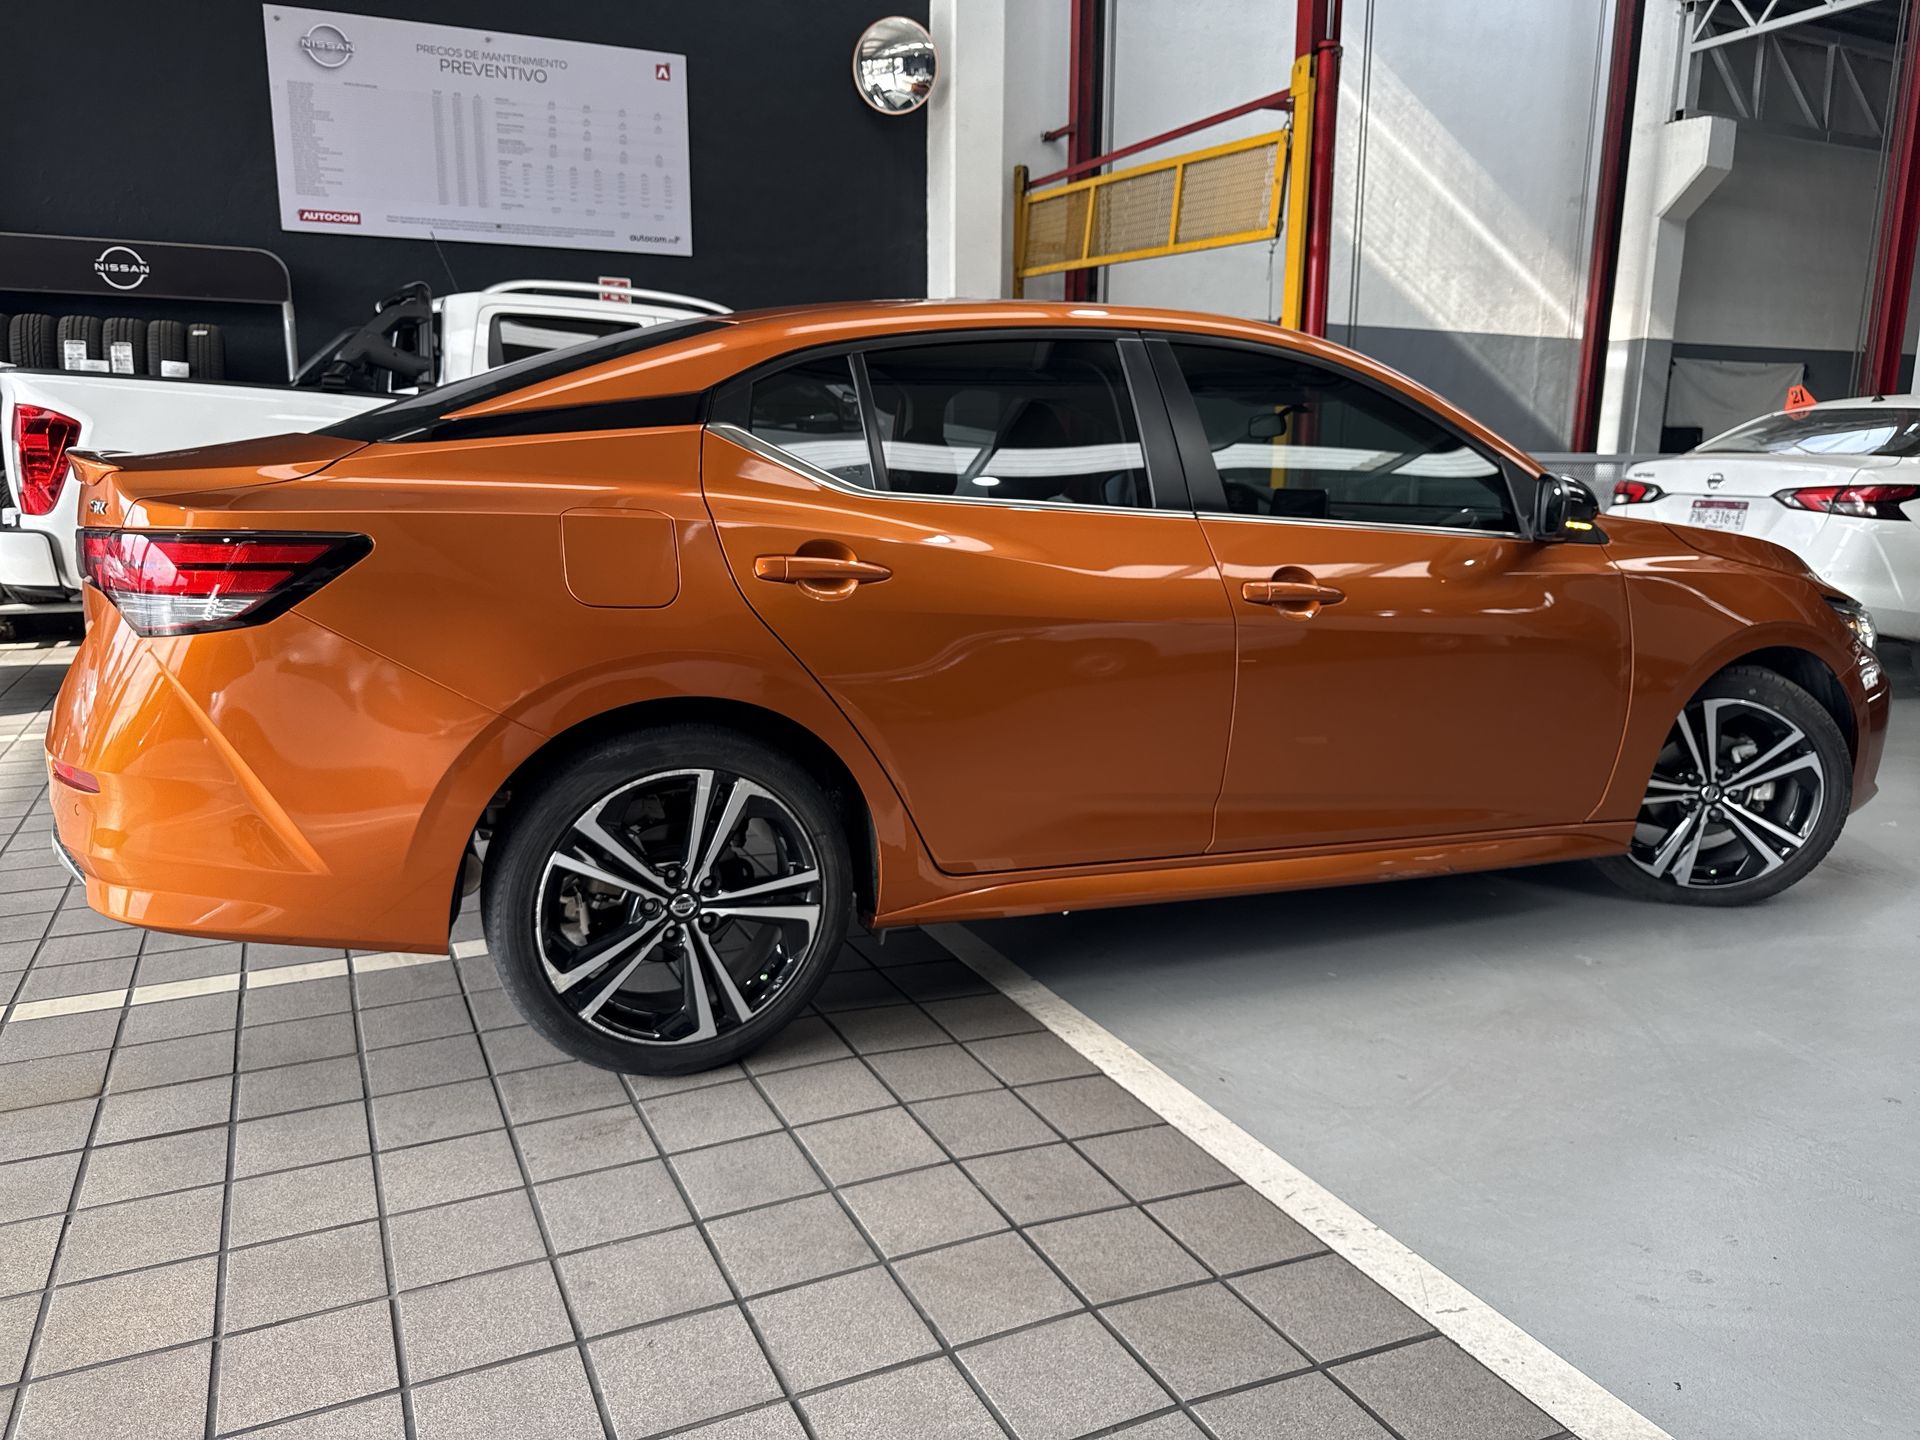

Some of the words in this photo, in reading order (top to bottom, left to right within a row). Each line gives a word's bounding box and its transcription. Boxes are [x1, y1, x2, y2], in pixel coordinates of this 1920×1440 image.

[301, 39, 356, 51] NISSAN
[416, 43, 463, 58] PRECIOS
[465, 49, 479, 60] DE
[481, 52, 568, 70] MANTENIMIENTO
[439, 58, 548, 84] PREVENTIVO
[303, 211, 359, 222] AUTOCOM
[94, 262, 150, 273] NISSAN
[1791, 389, 1805, 404] 21
